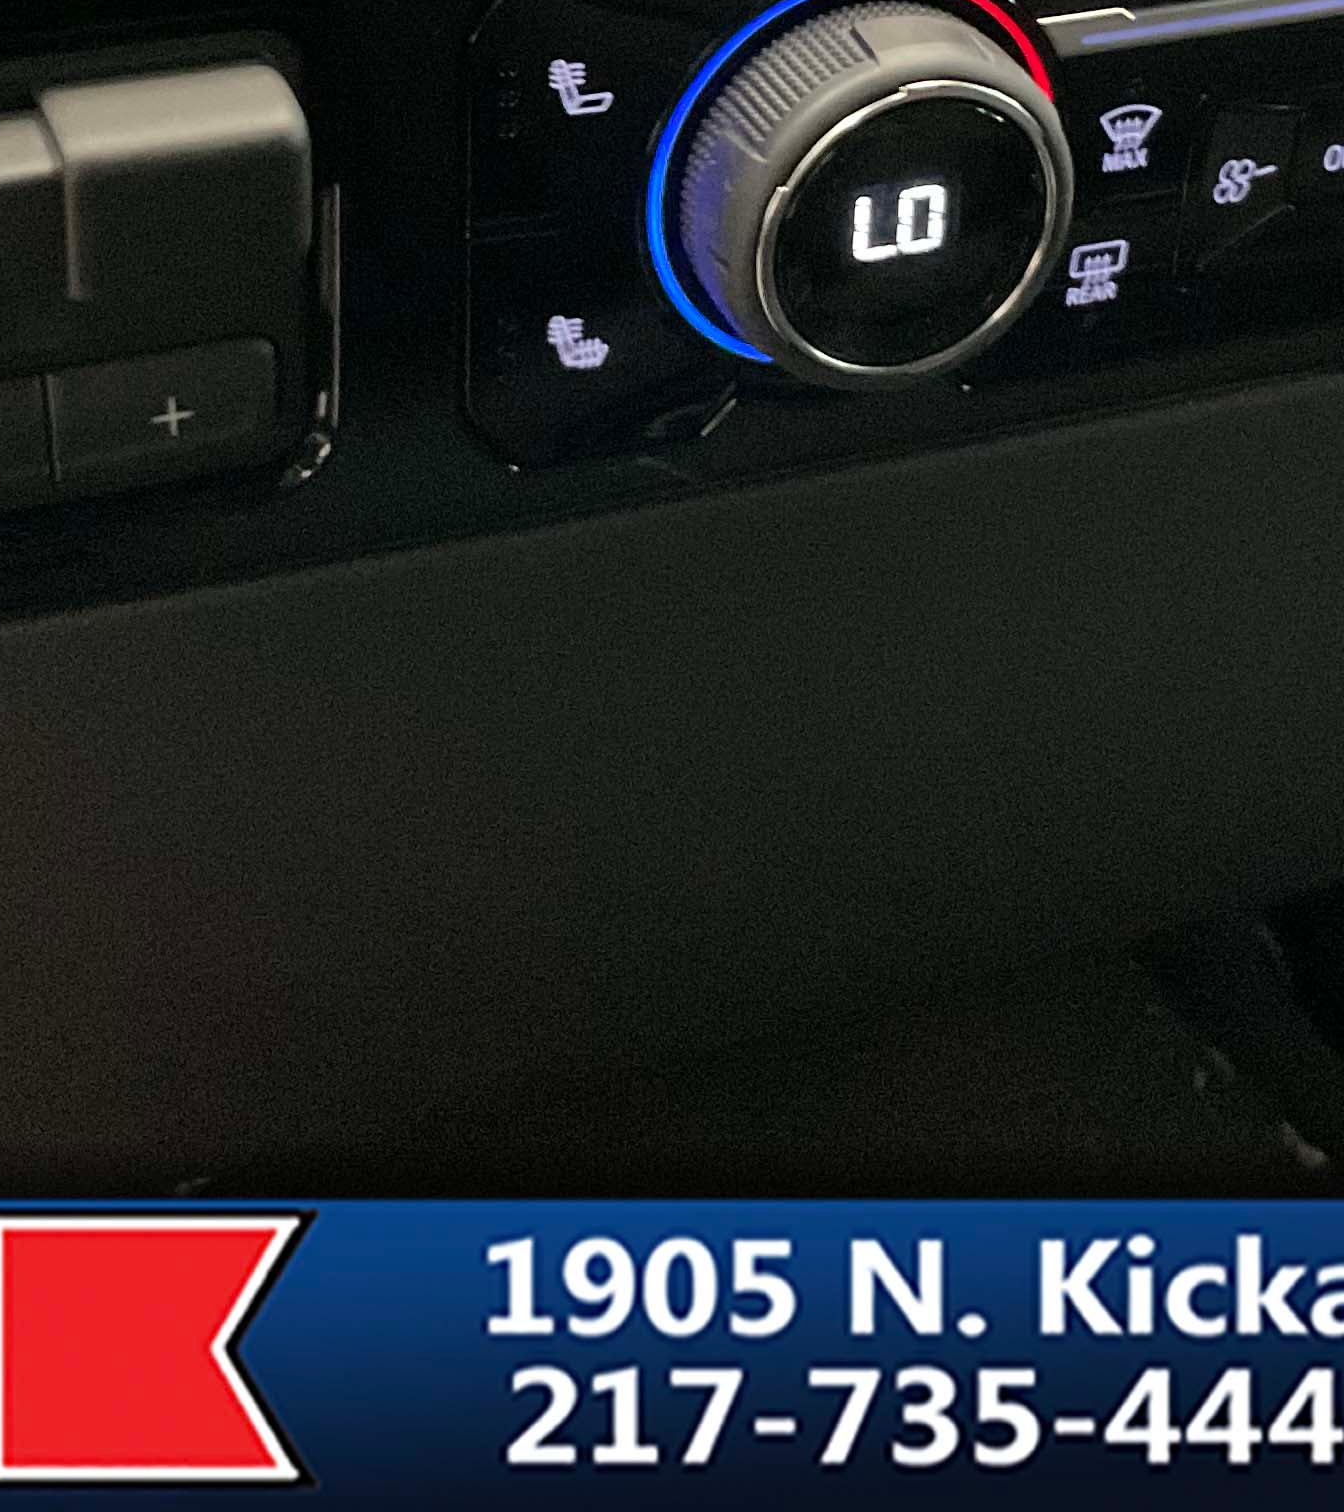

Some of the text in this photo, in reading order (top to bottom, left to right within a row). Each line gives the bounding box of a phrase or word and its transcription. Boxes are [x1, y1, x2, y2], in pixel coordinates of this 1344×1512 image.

[1102, 146, 1149, 173] MAX
[852, 183, 945, 263] LO
[1066, 280, 1118, 307] REAR
